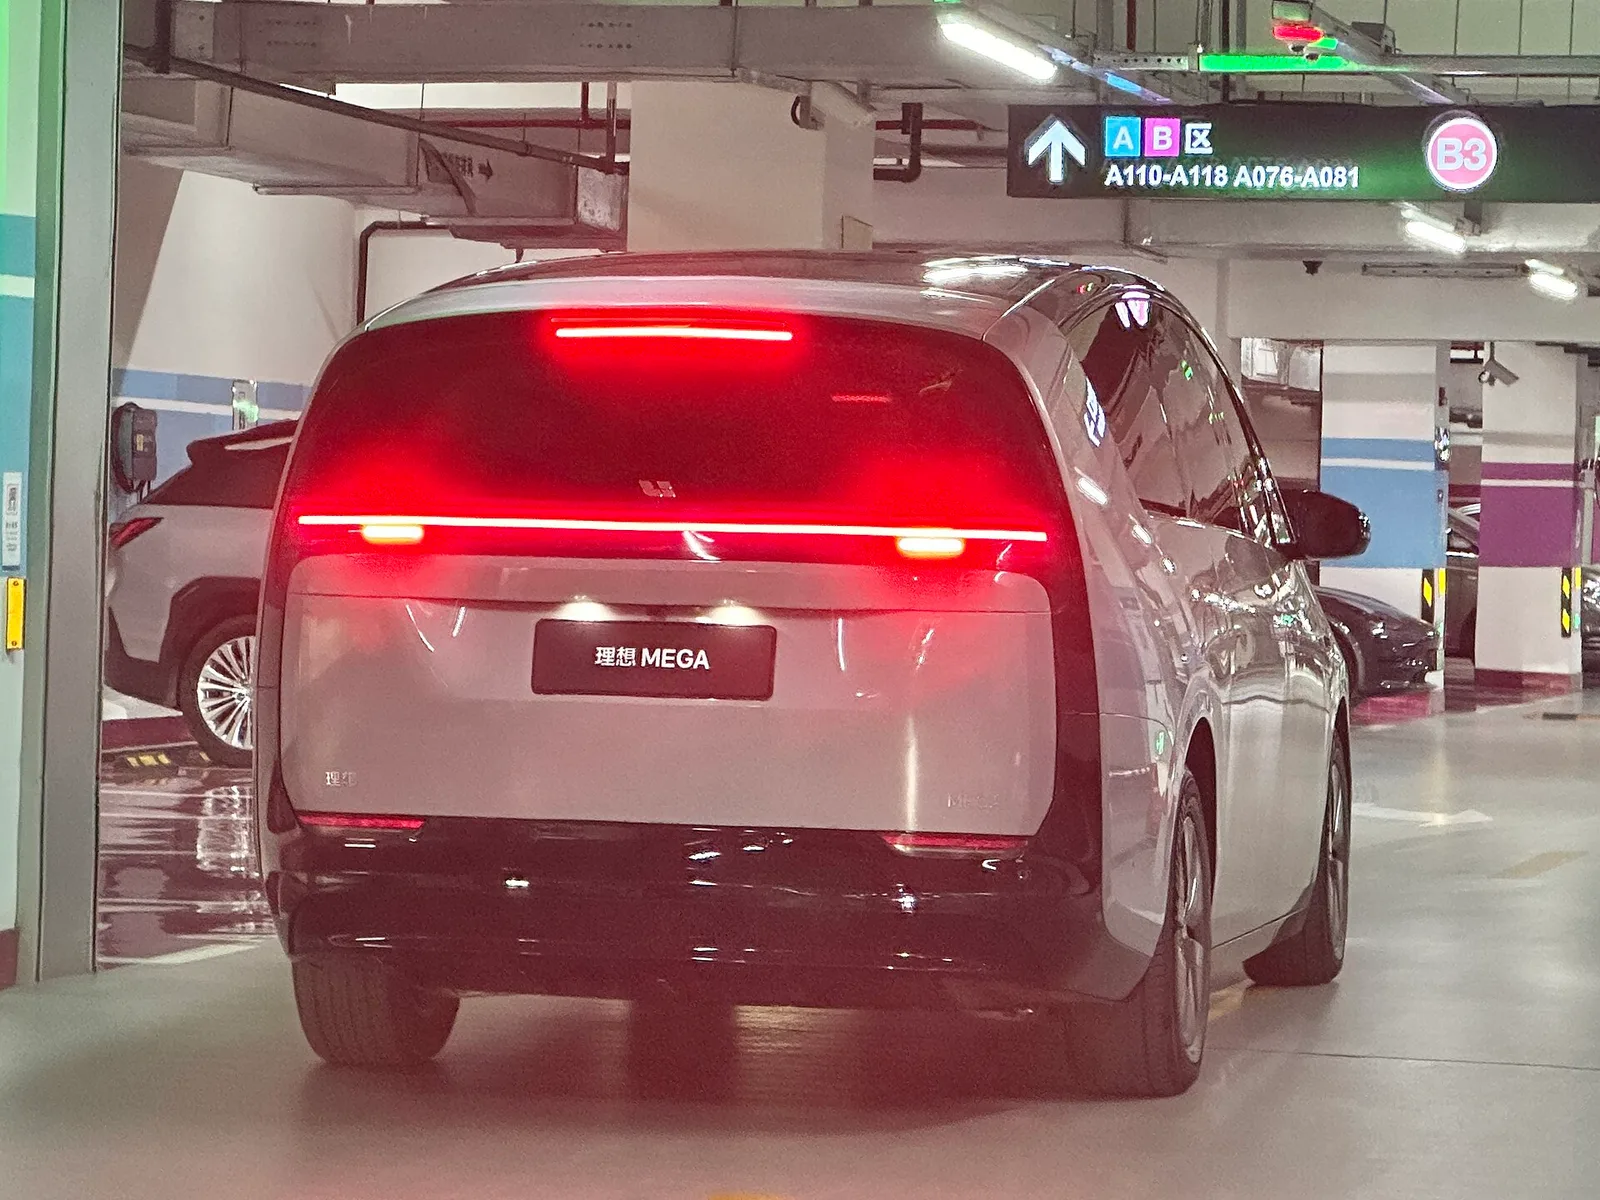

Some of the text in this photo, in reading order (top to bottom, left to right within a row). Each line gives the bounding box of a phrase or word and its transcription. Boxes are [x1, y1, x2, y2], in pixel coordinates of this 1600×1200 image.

[1112, 122, 1214, 155] A B 区
[1436, 137, 1488, 172] B3
[1103, 163, 1360, 189] A110-A118 A076-A081
[594, 645, 711, 671] 理想 MEGA
